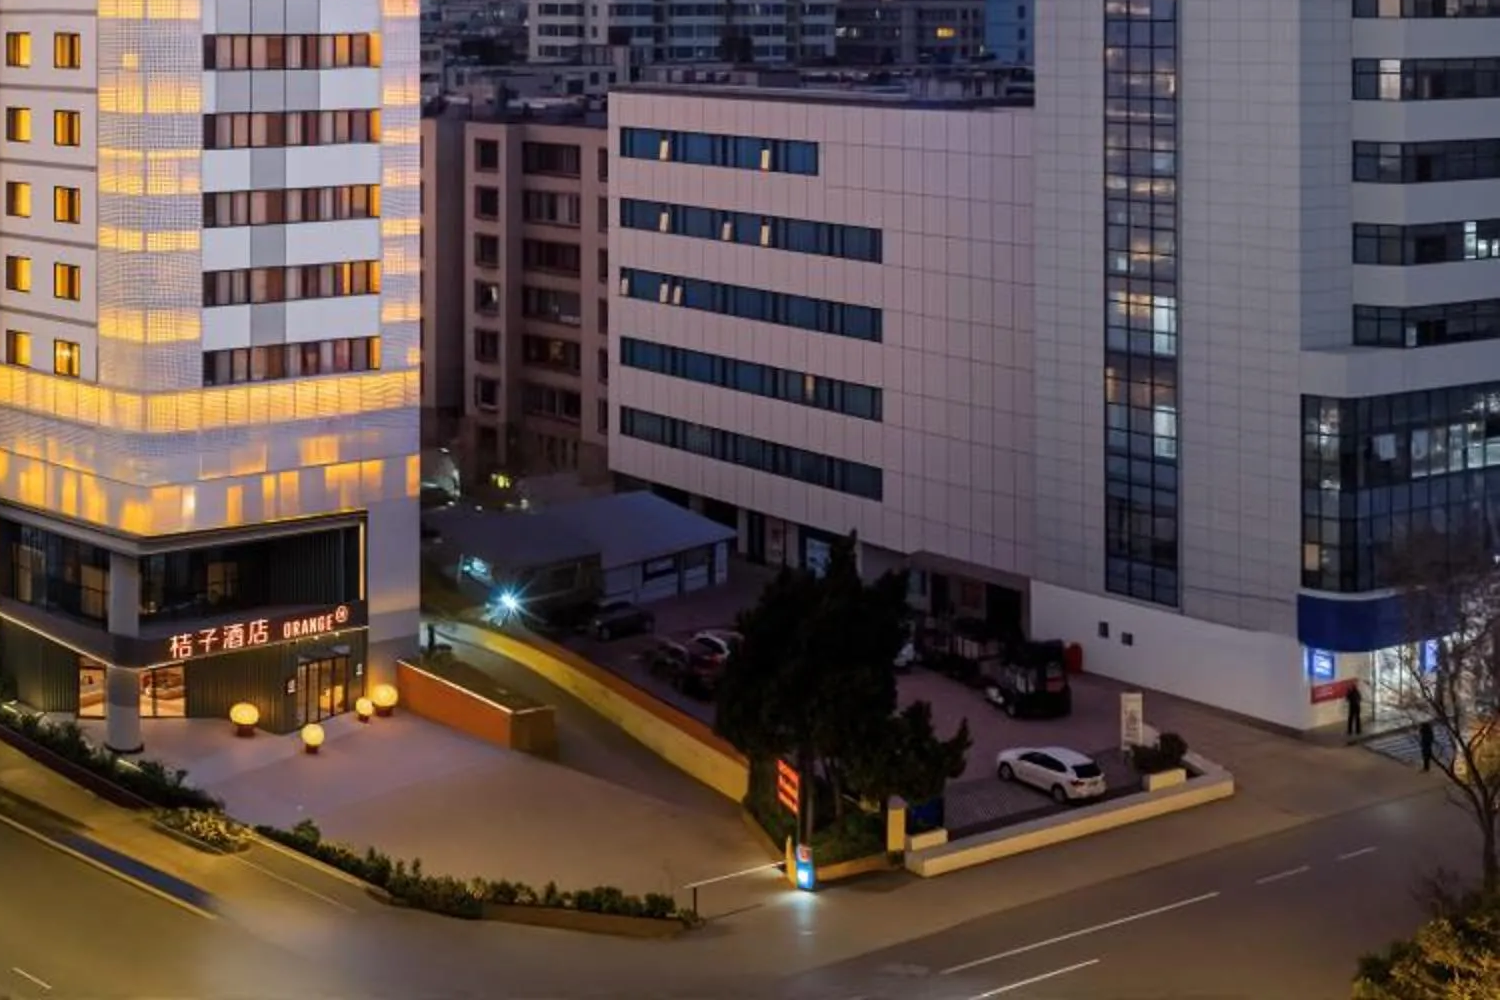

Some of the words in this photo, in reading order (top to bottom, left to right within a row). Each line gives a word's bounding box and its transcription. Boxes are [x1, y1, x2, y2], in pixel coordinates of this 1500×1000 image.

[169, 619, 269, 659] 桔子酒店
[283, 614, 334, 639] ORANGE
